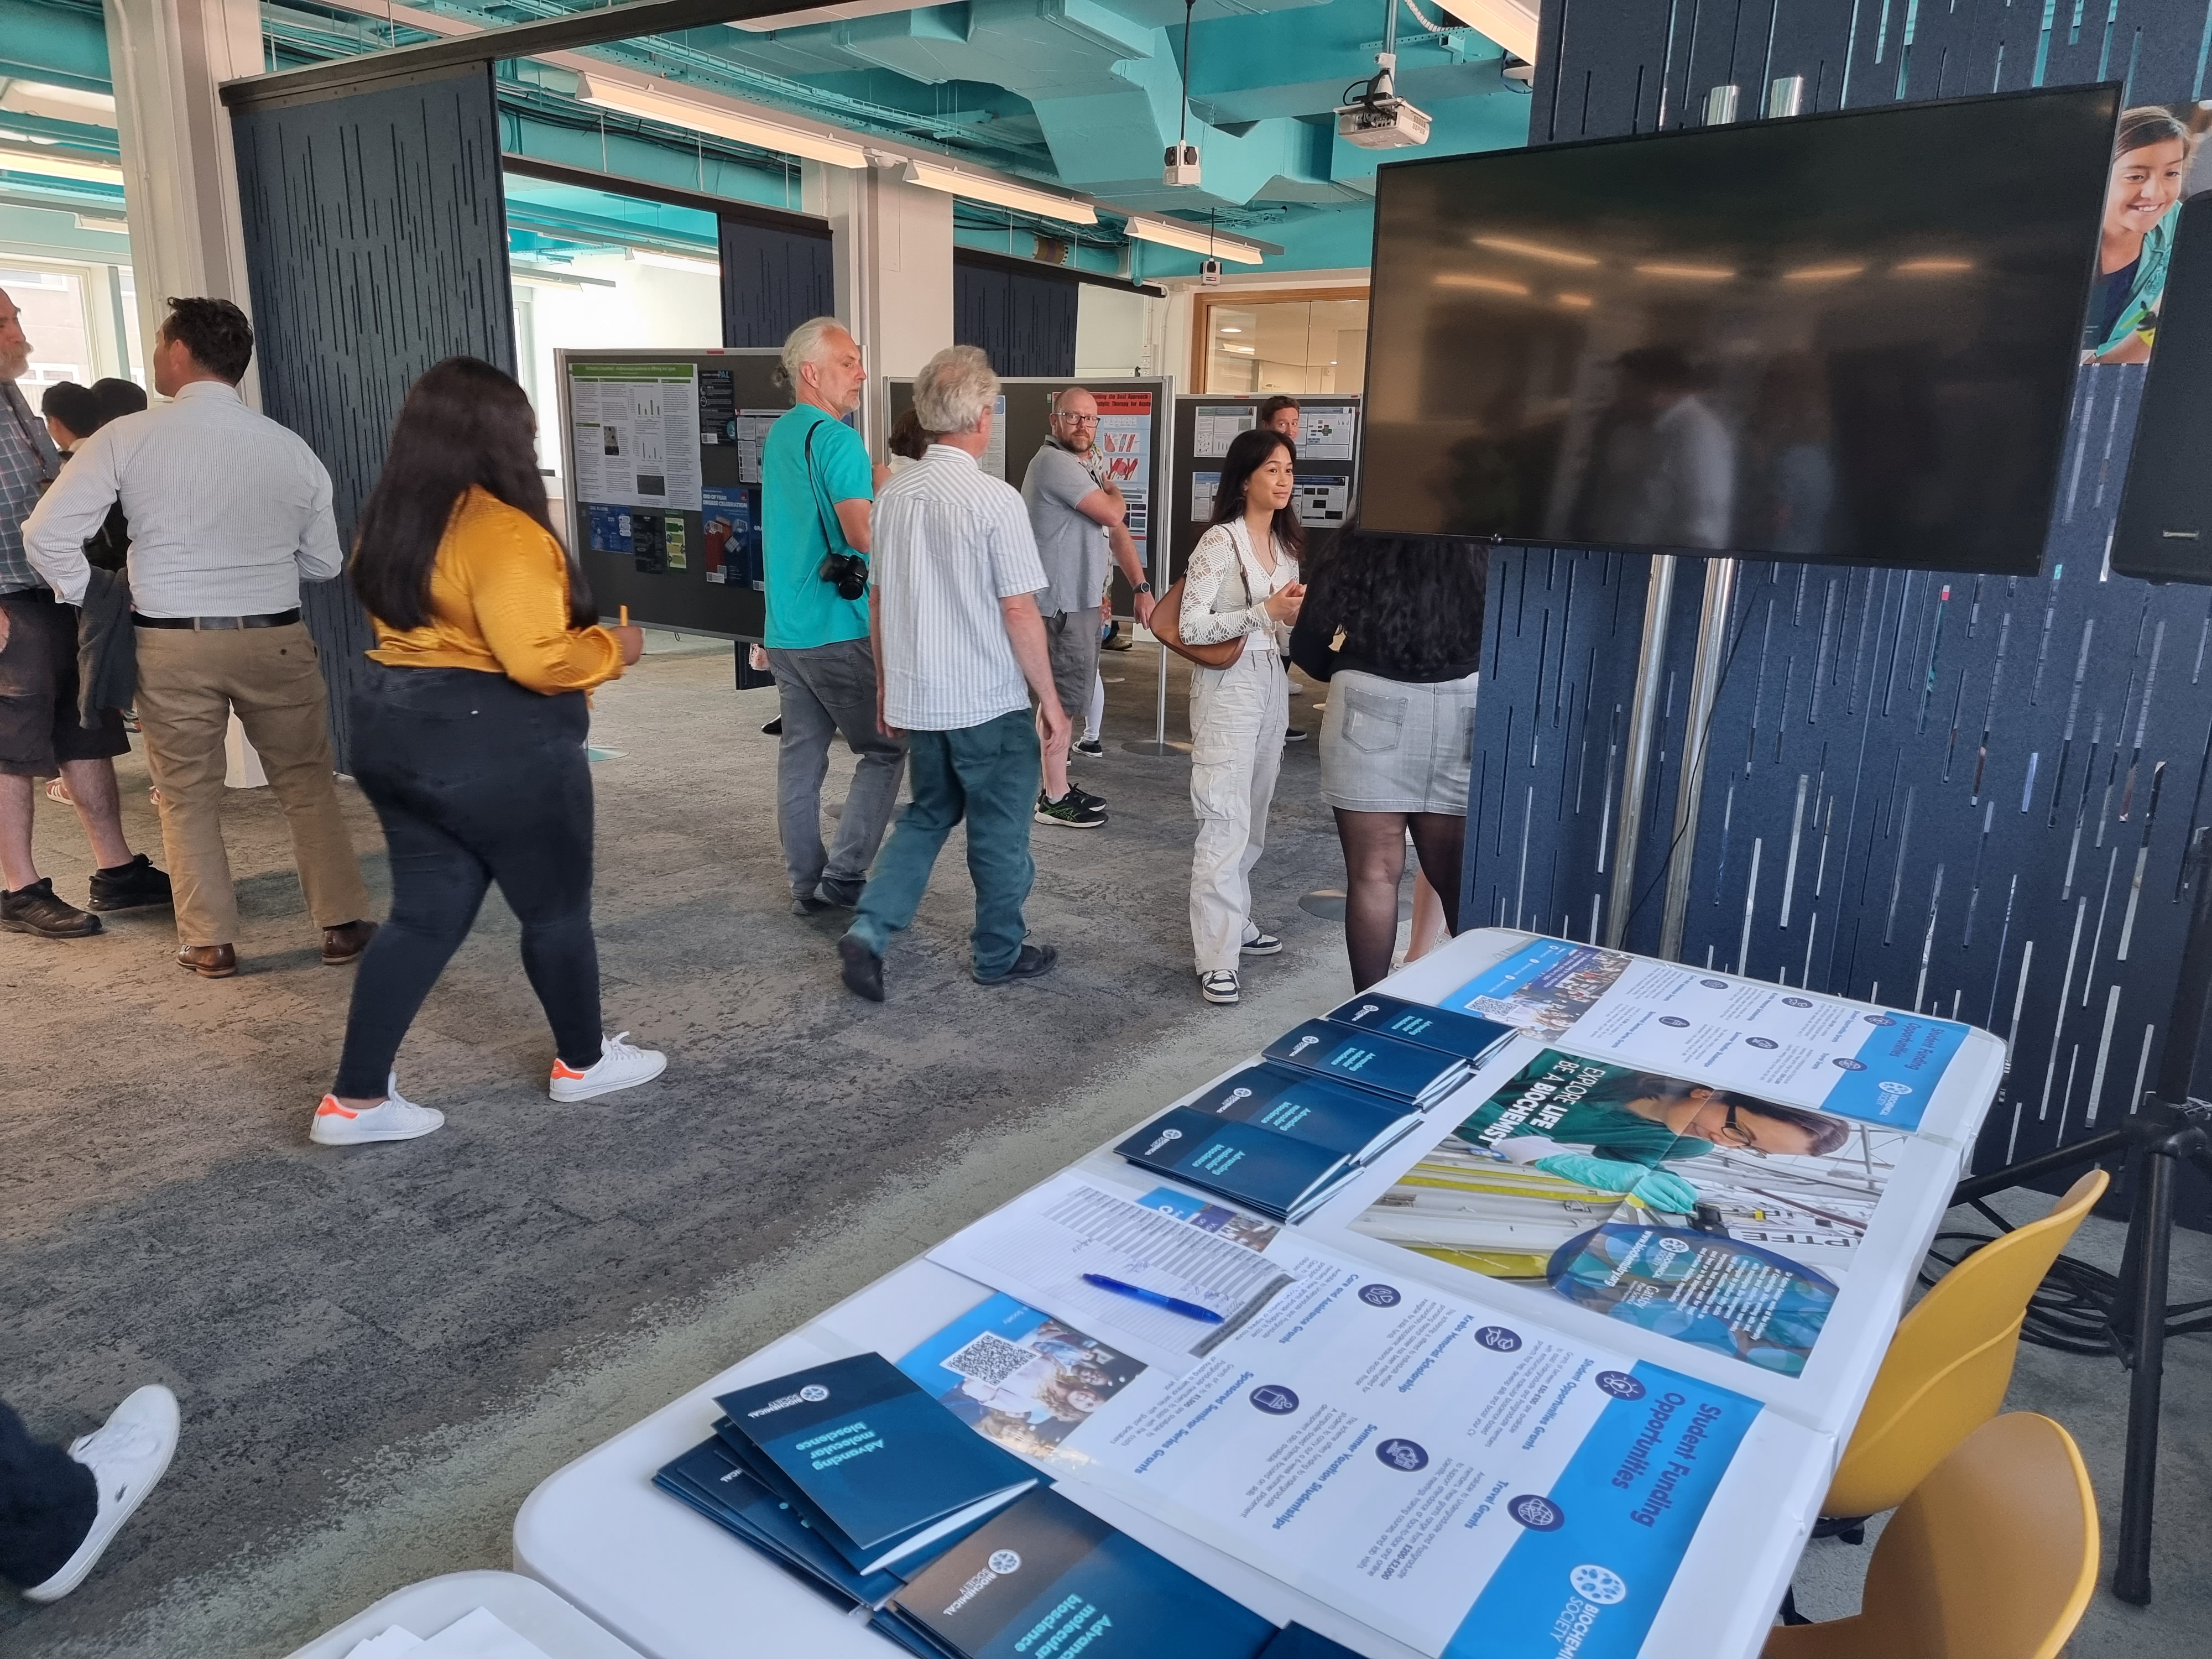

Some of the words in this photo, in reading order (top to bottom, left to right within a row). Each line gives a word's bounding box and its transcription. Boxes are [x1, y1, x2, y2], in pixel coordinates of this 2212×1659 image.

[1888, 1022, 1922, 1057] Opportunities
[1921, 1027, 1945, 1048] Student
[1331, 1047, 1357, 1066] bioscience
[1342, 1050, 1366, 1068] molecular
[1348, 1052, 1376, 1072] Advancing
[1552, 1060, 1580, 1074] BE
[1811, 1061, 1823, 1070] Grants
[1818, 1052, 1830, 1062] Travel
[1903, 1047, 1934, 1071] Funding
[1542, 1072, 1565, 1082] A
[1553, 1066, 1606, 1105] EXPLORE
[1216, 1096, 1240, 1113] BIOCHEMICAL
[1876, 1091, 1891, 1106] SOCIETY
[1879, 1094, 1900, 1116] BIOCHEMICAL
[1260, 1102, 1292, 1124] bioscience
[1272, 1105, 1301, 1126] molecular
[1279, 1108, 1312, 1131] Advancing
[1478, 1082, 1557, 1147] BIOCHEMIST
[1530, 1104, 1568, 1129] LIFE
[1144, 1138, 1170, 1156] BIOCHEMICAL
[1192, 1144, 1225, 1167] bioscience
[1204, 1147, 1234, 1170] molecular
[1212, 1150, 1245, 1176] Advancing
[1740, 1232, 1850, 1247] PTFE
[1604, 1230, 1653, 1287] www.biochemistry.org
[1651, 1249, 1668, 1266] SOCIETY
[1652, 1251, 1676, 1279] BIOCHEMICAL
[1342, 1274, 1359, 1287] Care
[1635, 1282, 1647, 1292] Plant
[1329, 1287, 1344, 1298] and
[1626, 1291, 1640, 1305] Science
[1631, 1284, 1661, 1310] Gatsby
[1300, 1297, 1333, 1325] Assistance
[1454, 1314, 1475, 1332] Krebs
[1279, 1326, 1303, 1344] Grants
[1430, 1332, 1459, 1358] Memorial
[1529, 1340, 1544, 1356] projects
[1541, 1343, 1554, 1353] with
[1549, 1353, 1559, 1364] assist
[1559, 1352, 1574, 1364] Grants
[1397, 1357, 1436, 1393] Scholarship
[1516, 1363, 1527, 1371] help
[1527, 1363, 1553, 1390] Undergraduate
[1545, 1369, 1561, 1385] between
[1571, 1358, 1595, 1382] Student
[1214, 1371, 1254, 1405] Sponsored
[1503, 1370, 1519, 1386] develop
[1509, 1378, 1526, 1398] molecular
[768, 1394, 801, 1407] SOCIETY
[1490, 1396, 1500, 1406] and
[1496, 1386, 1507, 1396] skills
[1520, 1389, 1530, 1399] and
[748, 1397, 803, 1418] BIOCHEMICAL
[1480, 1405, 1494, 1418] boost
[1500, 1399, 1525, 1427] Postgraduate
[1523, 1405, 1532, 1413] are
[1539, 1381, 1577, 1426] Opportunities
[1186, 1404, 1219, 1430] Seminar
[1473, 1417, 1483, 1429] your
[1480, 1397, 1513, 1436] bioscience-based
[1509, 1413, 1526, 1433] available
[795, 1422, 867, 1451] bioscience
[1161, 1429, 1189, 1449] Series
[1348, 1423, 1378, 1453] Summer
[1484, 1427, 1503, 1448] members
[1521, 1426, 1545, 1451] Grants
[1611, 1392, 1686, 1490] Opportunities
[1674, 1403, 1722, 1460] Student
[810, 1431, 875, 1459] molecular
[812, 1439, 884, 1470] Advancing
[1134, 1449, 1165, 1474] Grants
[1317, 1453, 1353, 1481] Vacation
[1434, 1457, 1453, 1477] scientific
[1416, 1477, 1438, 1496] meetings,
[1443, 1468, 1459, 1486] support
[1453, 1467, 1474, 1488] members,
[1465, 1471, 1485, 1492] Available
[1420, 1485, 1444, 1511] attendance
[1443, 1489, 1458, 1501] these
[1484, 1480, 1509, 1505] Travel
[1630, 1461, 1691, 1528] Funding
[1272, 1482, 1323, 1530] Studentships
[1400, 1497, 1421, 1515] training
[1431, 1500, 1447, 1516] grants
[1432, 1499, 1465, 1533] Undergraduate
[1464, 1504, 1490, 1529] Grants
[1385, 1515, 1405, 1533] courses,
[1390, 1517, 1420, 1548] face-to-face
[1419, 1516, 1434, 1531] range
[1376, 1535, 1388, 1547] and
[1409, 1531, 1423, 1544] from
[1423, 1533, 1436, 1545] and
[1368, 1545, 1380, 1556] lab
[1380, 1548, 1392, 1560] and
[1367, 1559, 1383, 1577] online
[1396, 1544, 1429, 1579] Postgraduate
[959, 1568, 993, 1596] SOCIETY
[943, 1572, 997, 1615] BIOCHEMICAL
[1014, 1594, 1083, 1652] bioscience
[1550, 1596, 1584, 1643] SOCIETY
[1035, 1604, 1096, 1659] molecular
